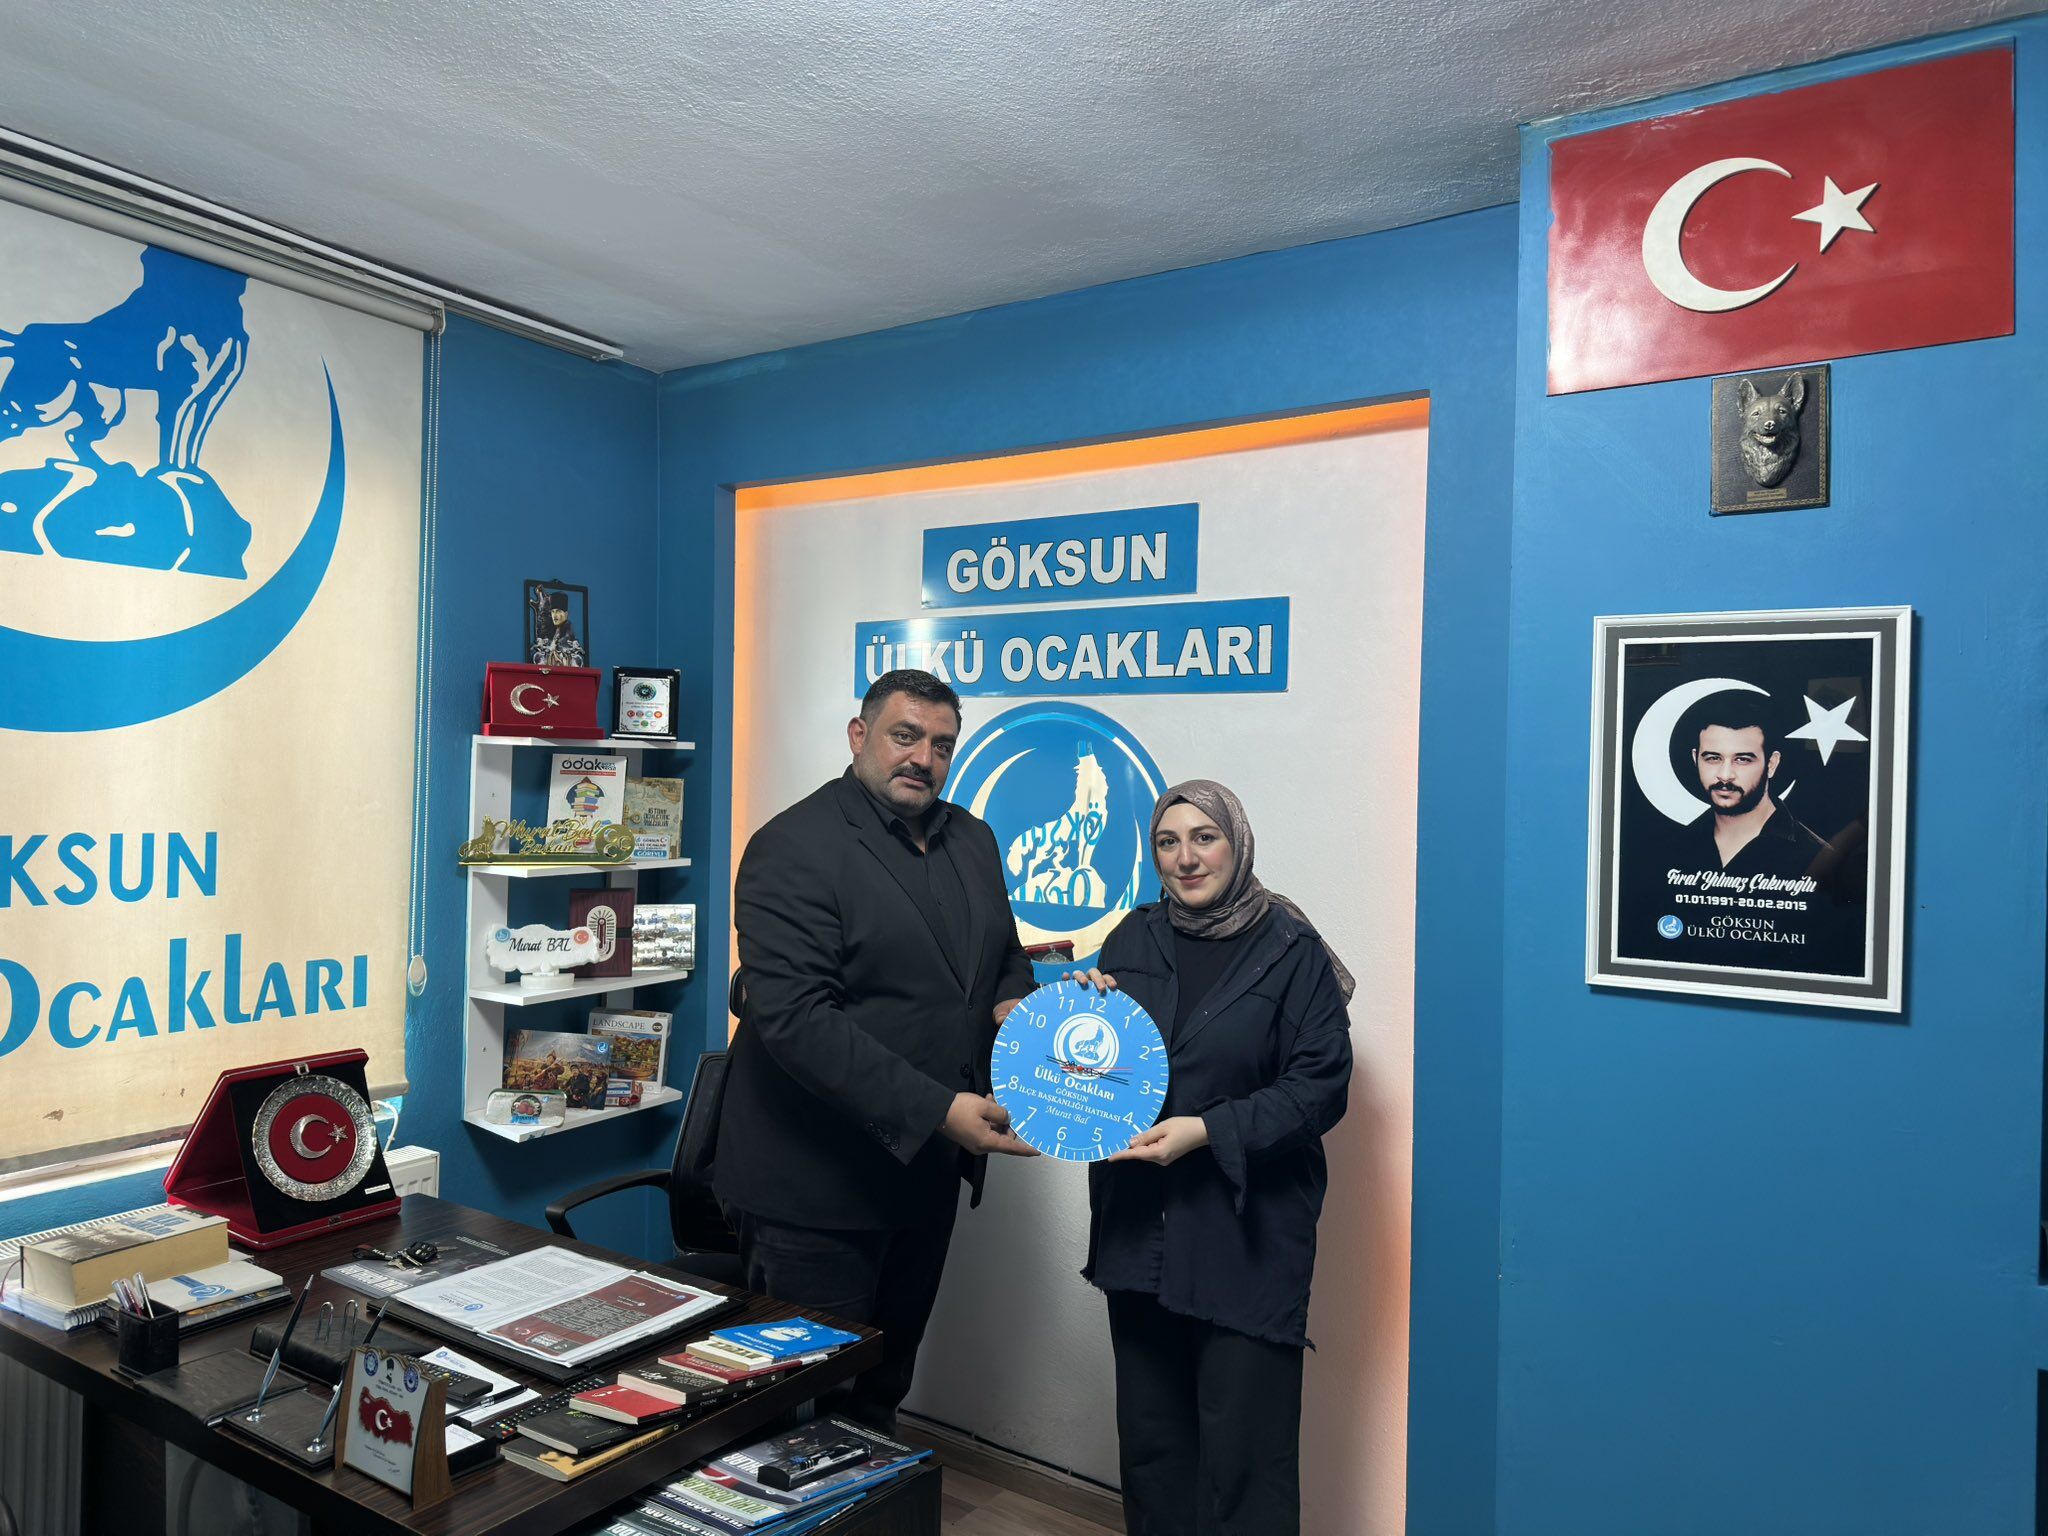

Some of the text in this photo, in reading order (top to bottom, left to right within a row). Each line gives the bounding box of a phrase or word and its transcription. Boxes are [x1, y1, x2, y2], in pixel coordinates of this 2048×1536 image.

[946, 532, 1168, 594] GÖKSUN
[1000, 624, 1273, 682] OCAKLARI
[1667, 868, 1818, 897] Fırat Yılmaz Çakıroğlu
[1710, 915, 1775, 930] GÖKSUN
[1687, 924, 1805, 945] ÜLKÜ OCAKLARI
[509, 938, 571, 952] Murat BAL
[1058, 996, 1074, 1012] 11
[1089, 996, 1107, 1012] 12
[593, 1018, 645, 1030] LANDSCAPE
[1028, 1012, 1046, 1028] 10
[1124, 1015, 1130, 1029] 1
[1009, 1041, 1020, 1055] 9
[1139, 1046, 1149, 1060] 2
[1034, 1064, 1061, 1084] Ülkü
[1008, 1076, 1019, 1090] 8
[1140, 1081, 1150, 1095] 3
[1055, 1087, 1089, 1103] GÖKSUN
[1027, 1106, 1037, 1121] 7
[1045, 1105, 1091, 1125] Murat Bal
[1122, 1111, 1134, 1125] 4
[1056, 1126, 1068, 1141] 6
[1091, 1128, 1103, 1142] 5
